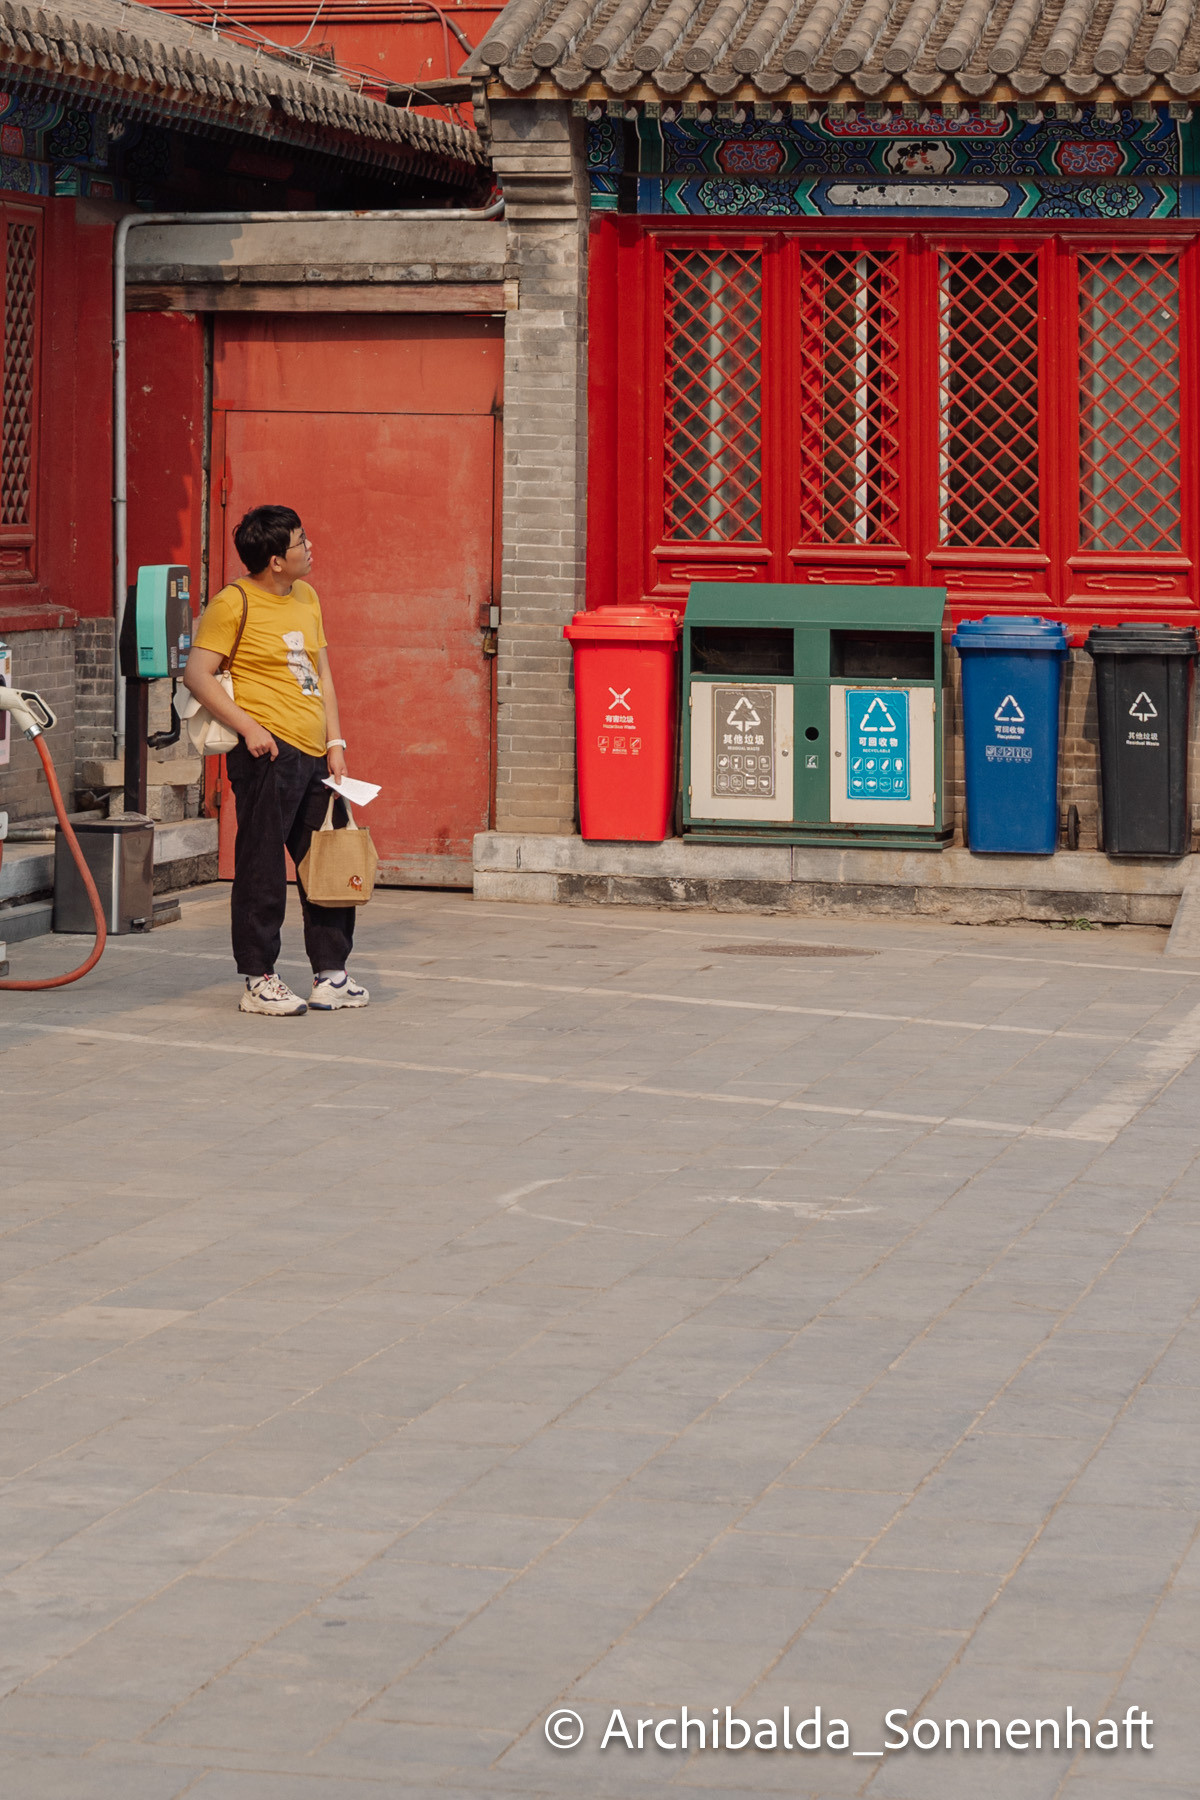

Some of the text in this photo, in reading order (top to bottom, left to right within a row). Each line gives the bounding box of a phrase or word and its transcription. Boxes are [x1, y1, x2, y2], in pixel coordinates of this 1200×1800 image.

[605, 715, 634, 723] 有害垃圾
[994, 725, 1025, 734] 可回收物
[723, 734, 764, 745] 其他垃圾
[1128, 732, 1158, 740] 其他垃圾
[859, 737, 898, 747] 可回收物
